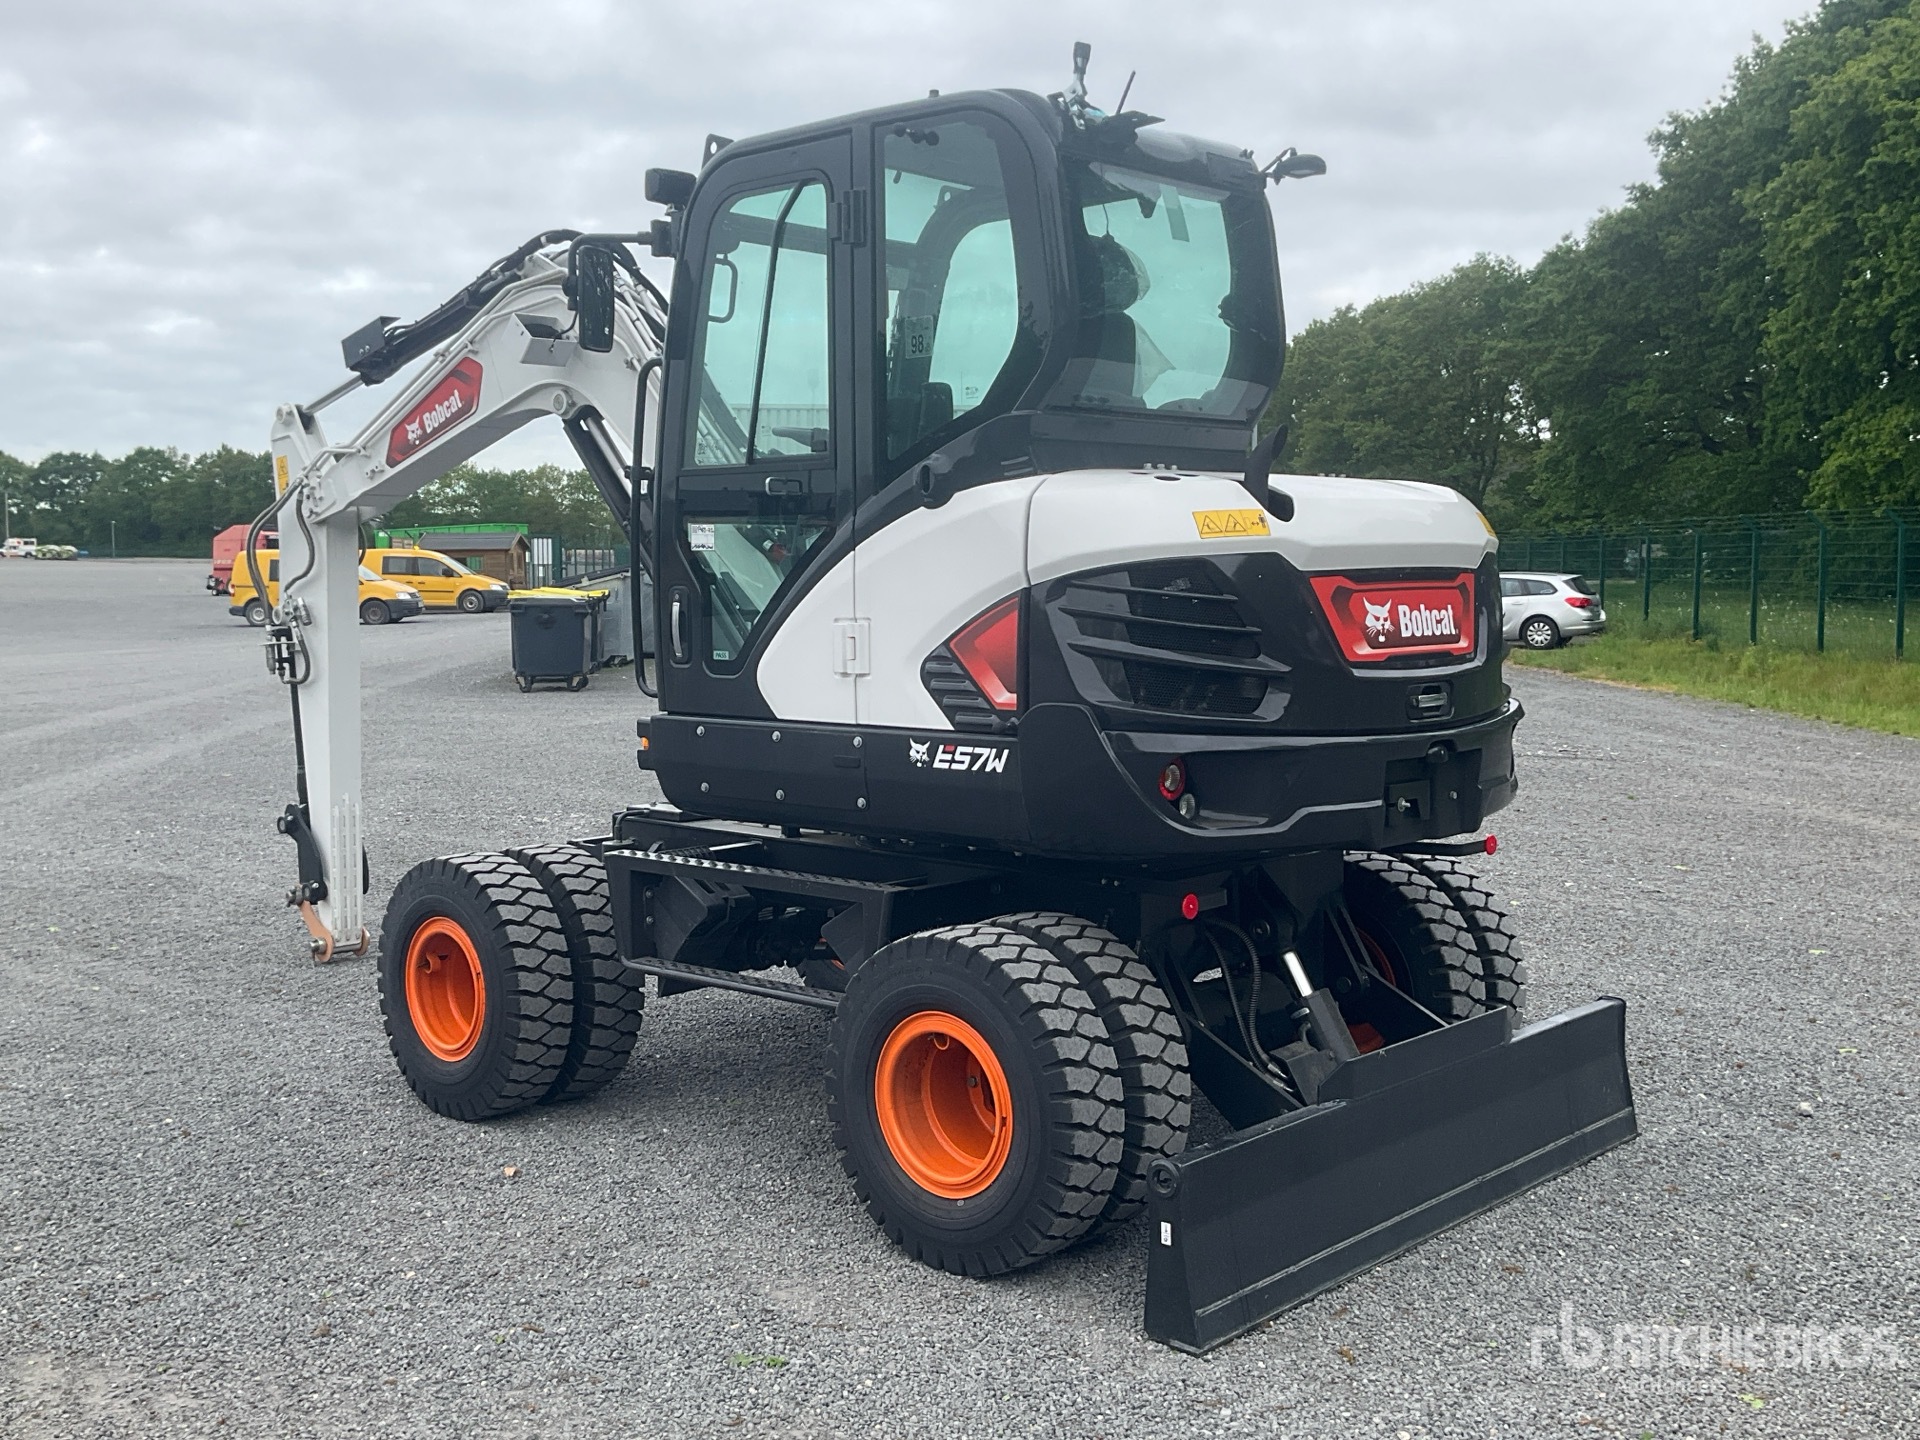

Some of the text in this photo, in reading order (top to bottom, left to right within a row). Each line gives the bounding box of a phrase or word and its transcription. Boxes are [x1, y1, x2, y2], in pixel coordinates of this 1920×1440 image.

[911, 334, 924, 353] 98
[422, 389, 463, 433] Bobcat
[1397, 603, 1456, 637] Bobcat
[932, 744, 1010, 773] E57W
